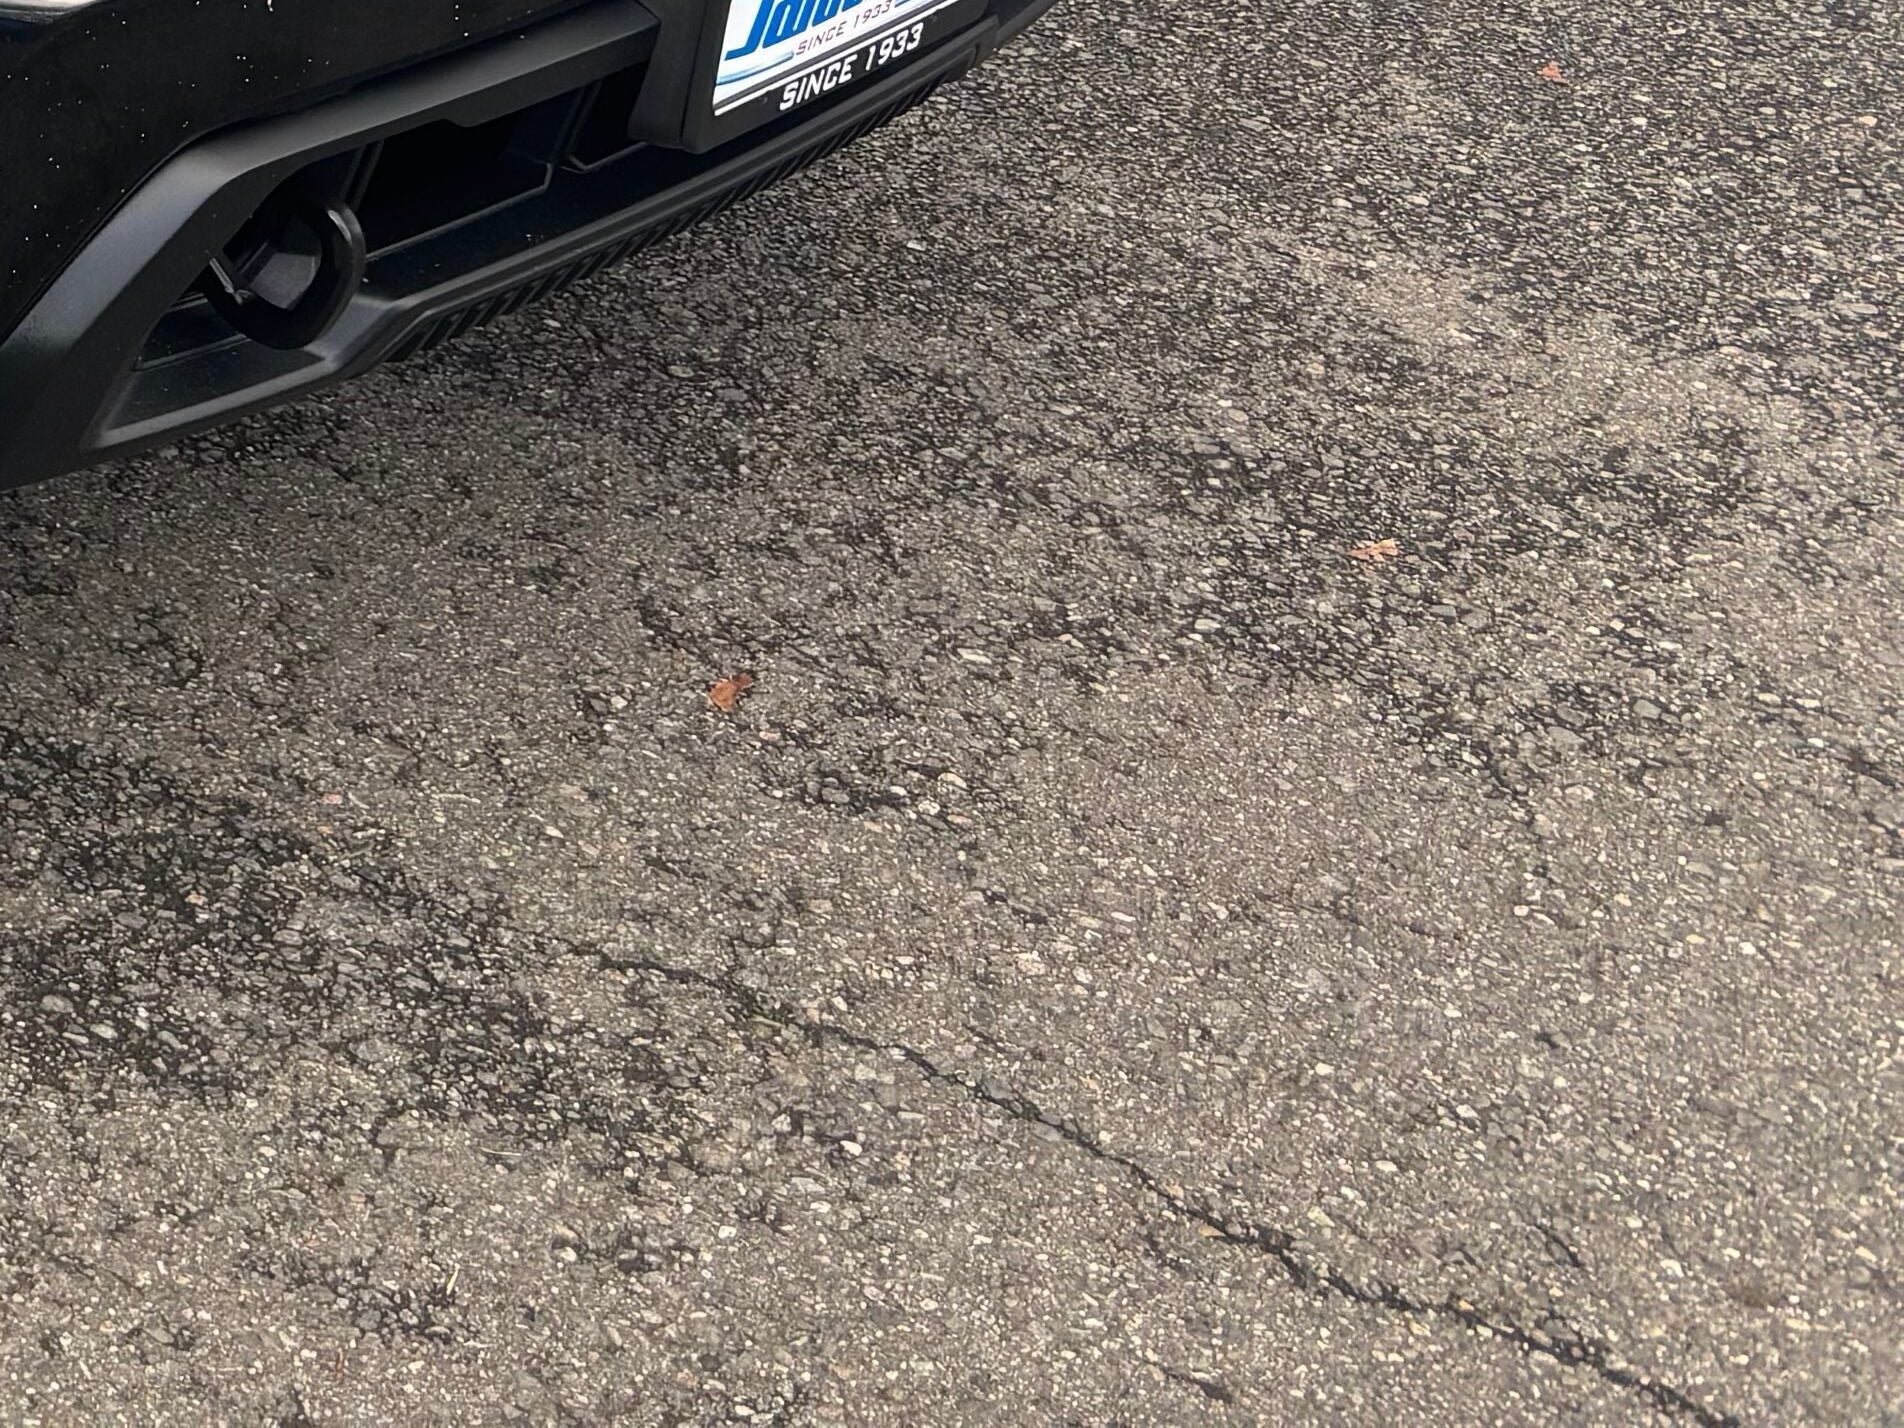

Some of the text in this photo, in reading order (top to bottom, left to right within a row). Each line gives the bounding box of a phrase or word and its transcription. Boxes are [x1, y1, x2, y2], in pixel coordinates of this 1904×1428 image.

[779, 22, 924, 111] SINCE 1933
[796, 21, 847, 56] SINCE
